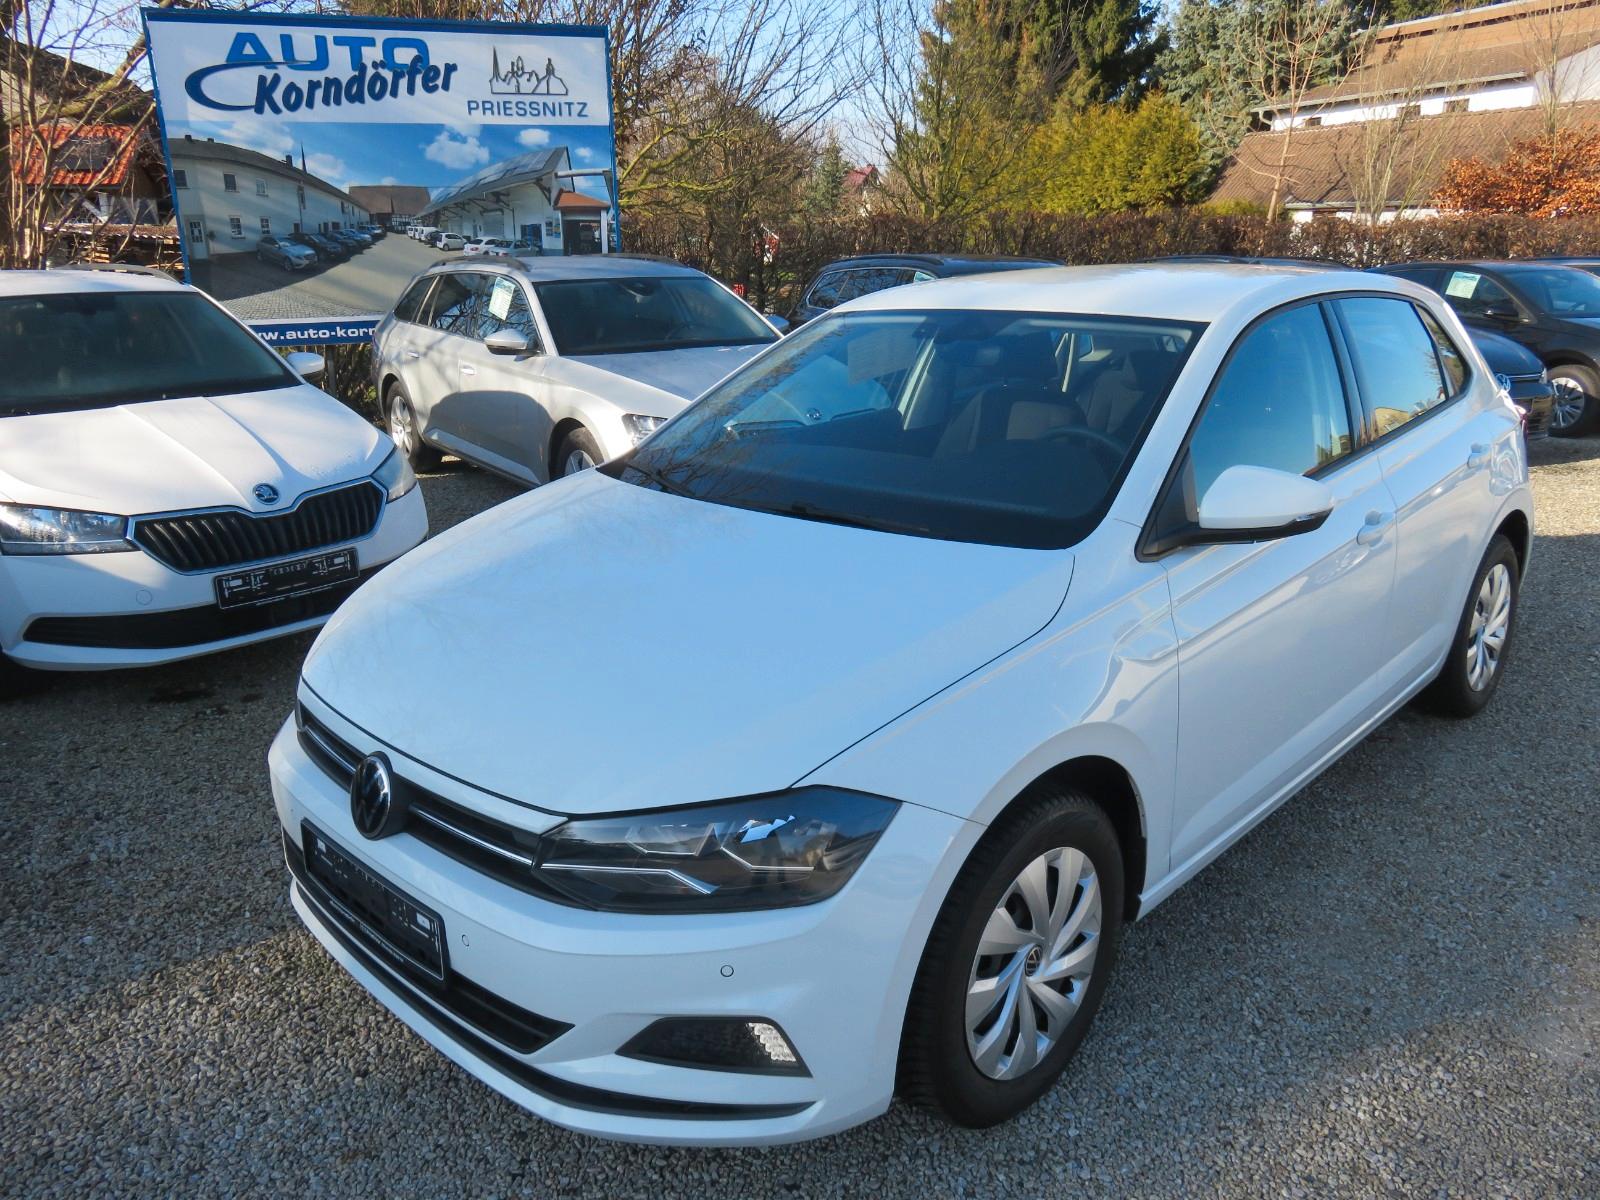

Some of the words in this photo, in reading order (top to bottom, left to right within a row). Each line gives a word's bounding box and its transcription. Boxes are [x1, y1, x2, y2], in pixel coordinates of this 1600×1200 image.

[225, 32, 430, 71] AUTO
[254, 54, 458, 114] Korndörfer
[467, 100, 589, 117] PRIESSNITZ
